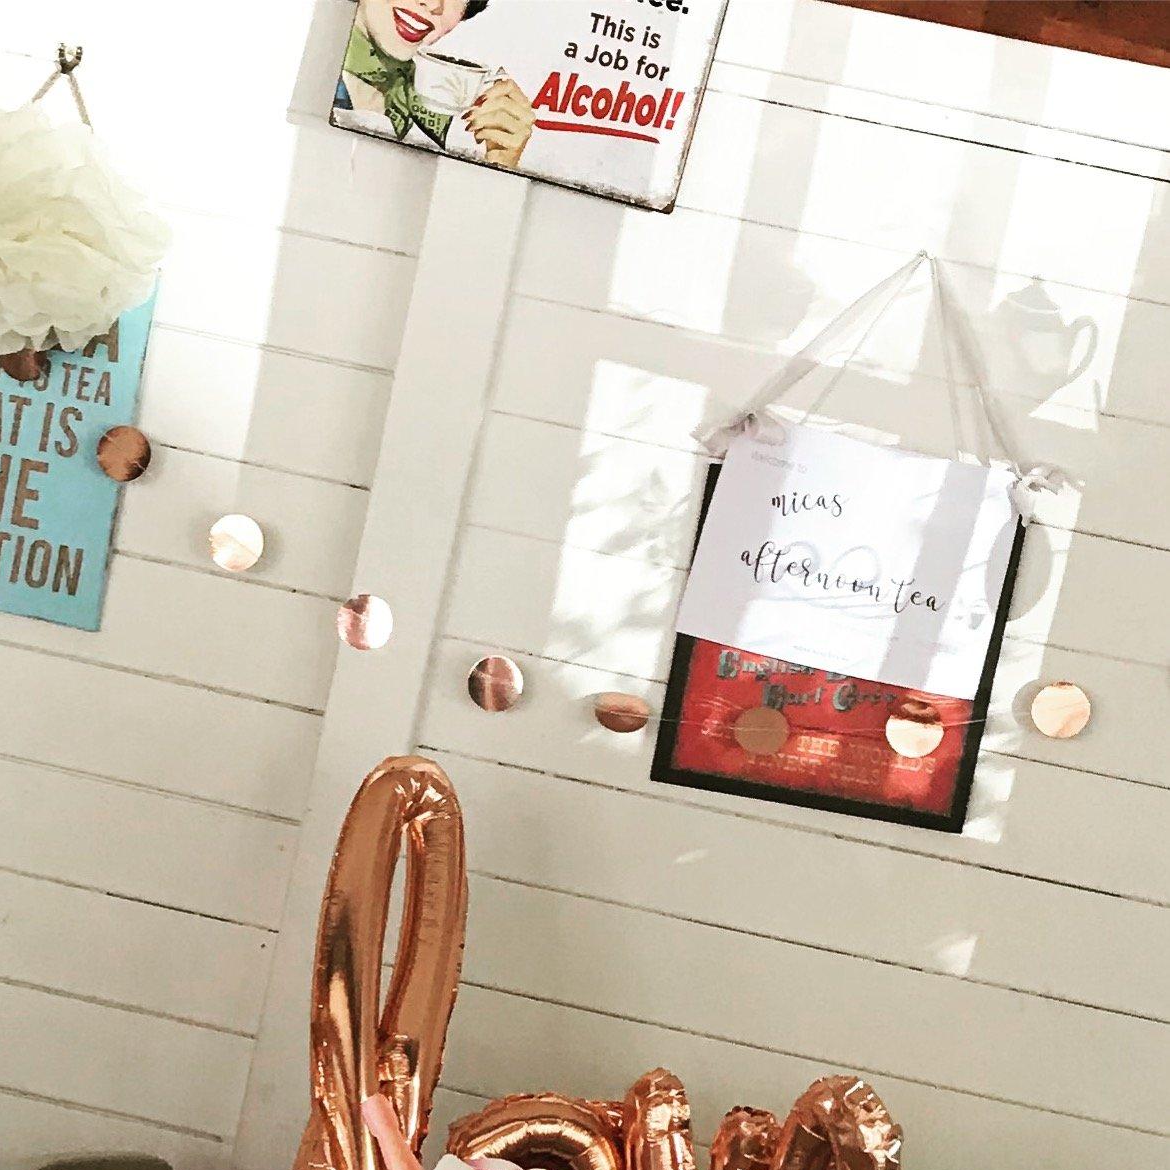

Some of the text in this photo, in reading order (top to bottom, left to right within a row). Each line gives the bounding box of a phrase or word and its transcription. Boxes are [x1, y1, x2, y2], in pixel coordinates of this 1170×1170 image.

[590, 12, 662, 49] This is
[564, 42, 670, 81] a Job for
[531, 71, 685, 130] Alcohol!
[61, 361, 112, 406] TEA
[37, 402, 83, 458] IS
